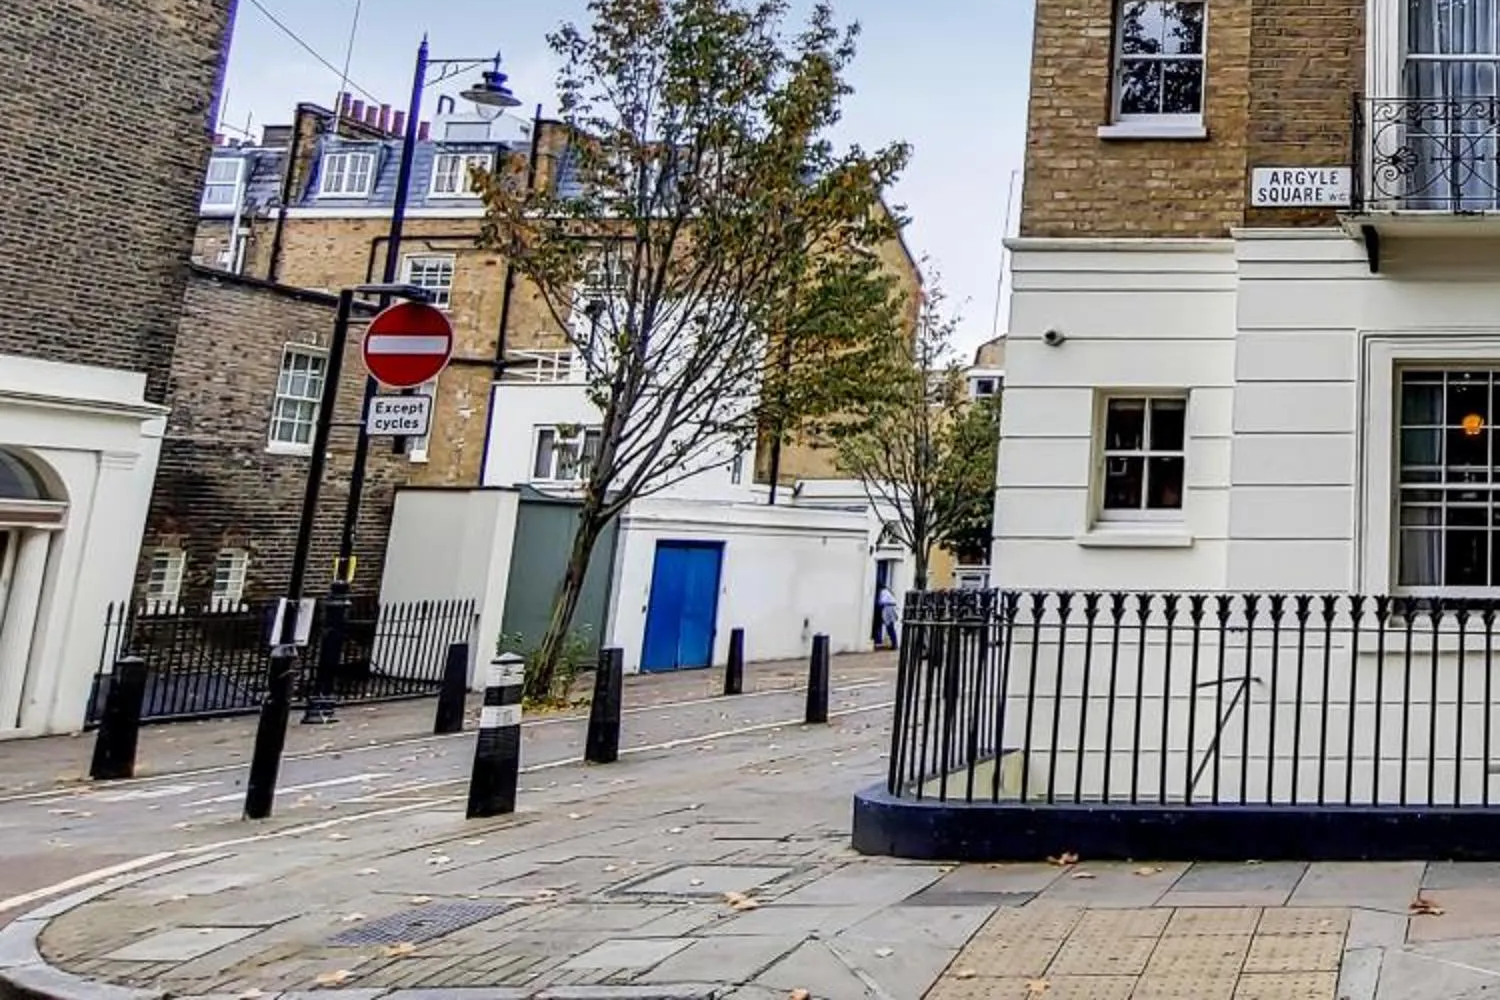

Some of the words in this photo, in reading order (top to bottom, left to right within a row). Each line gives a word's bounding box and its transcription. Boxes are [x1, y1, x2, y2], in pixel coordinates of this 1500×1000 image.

[1269, 171, 1339, 185] ARGYLE
[1257, 187, 1324, 202] SQUARE
[375, 401, 424, 415] Except
[375, 417, 419, 431] cycles
